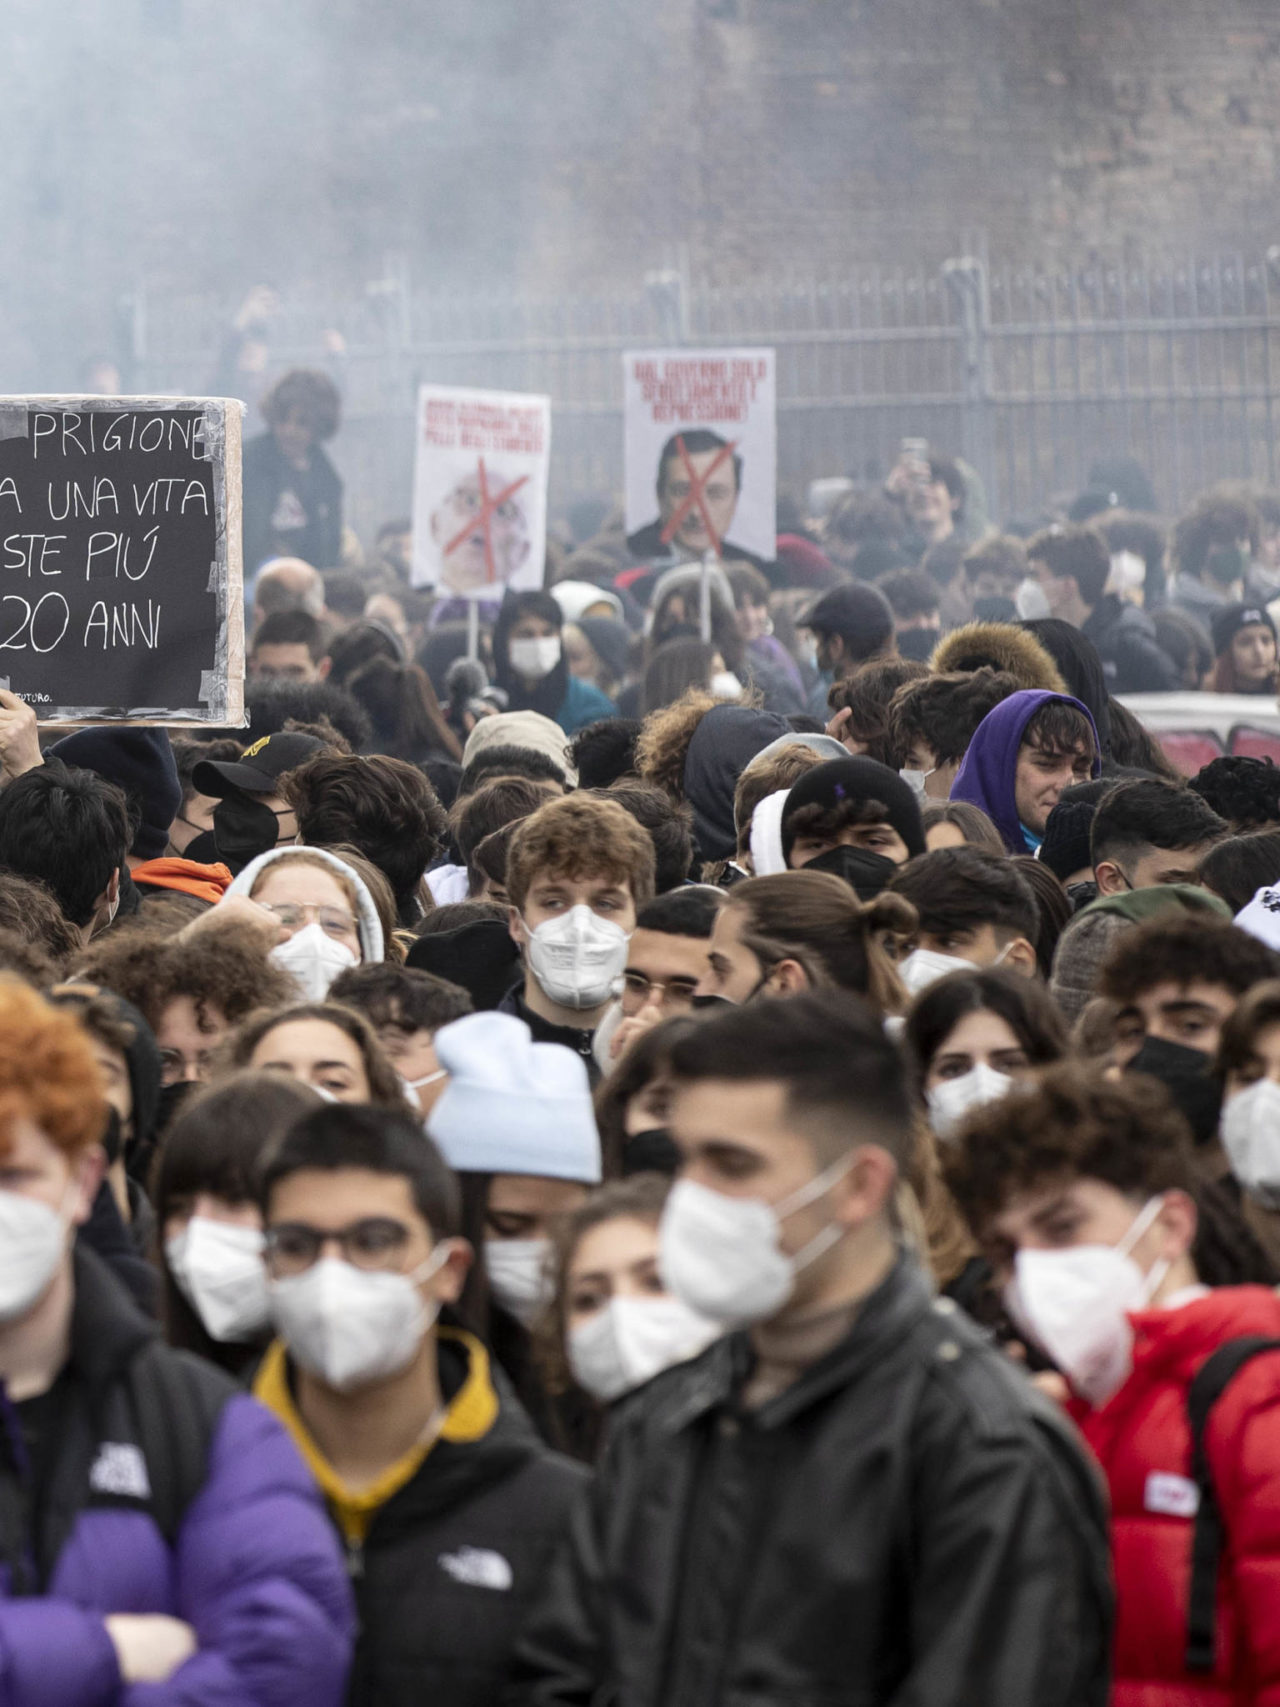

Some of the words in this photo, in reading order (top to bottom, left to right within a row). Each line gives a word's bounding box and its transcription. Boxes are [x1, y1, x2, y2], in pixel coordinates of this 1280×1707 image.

[33, 413, 211, 460] PRIGIONE
[49, 476, 120, 521] UNA
[132, 478, 209, 517] VITA
[84, 599, 161, 650] ANNI
